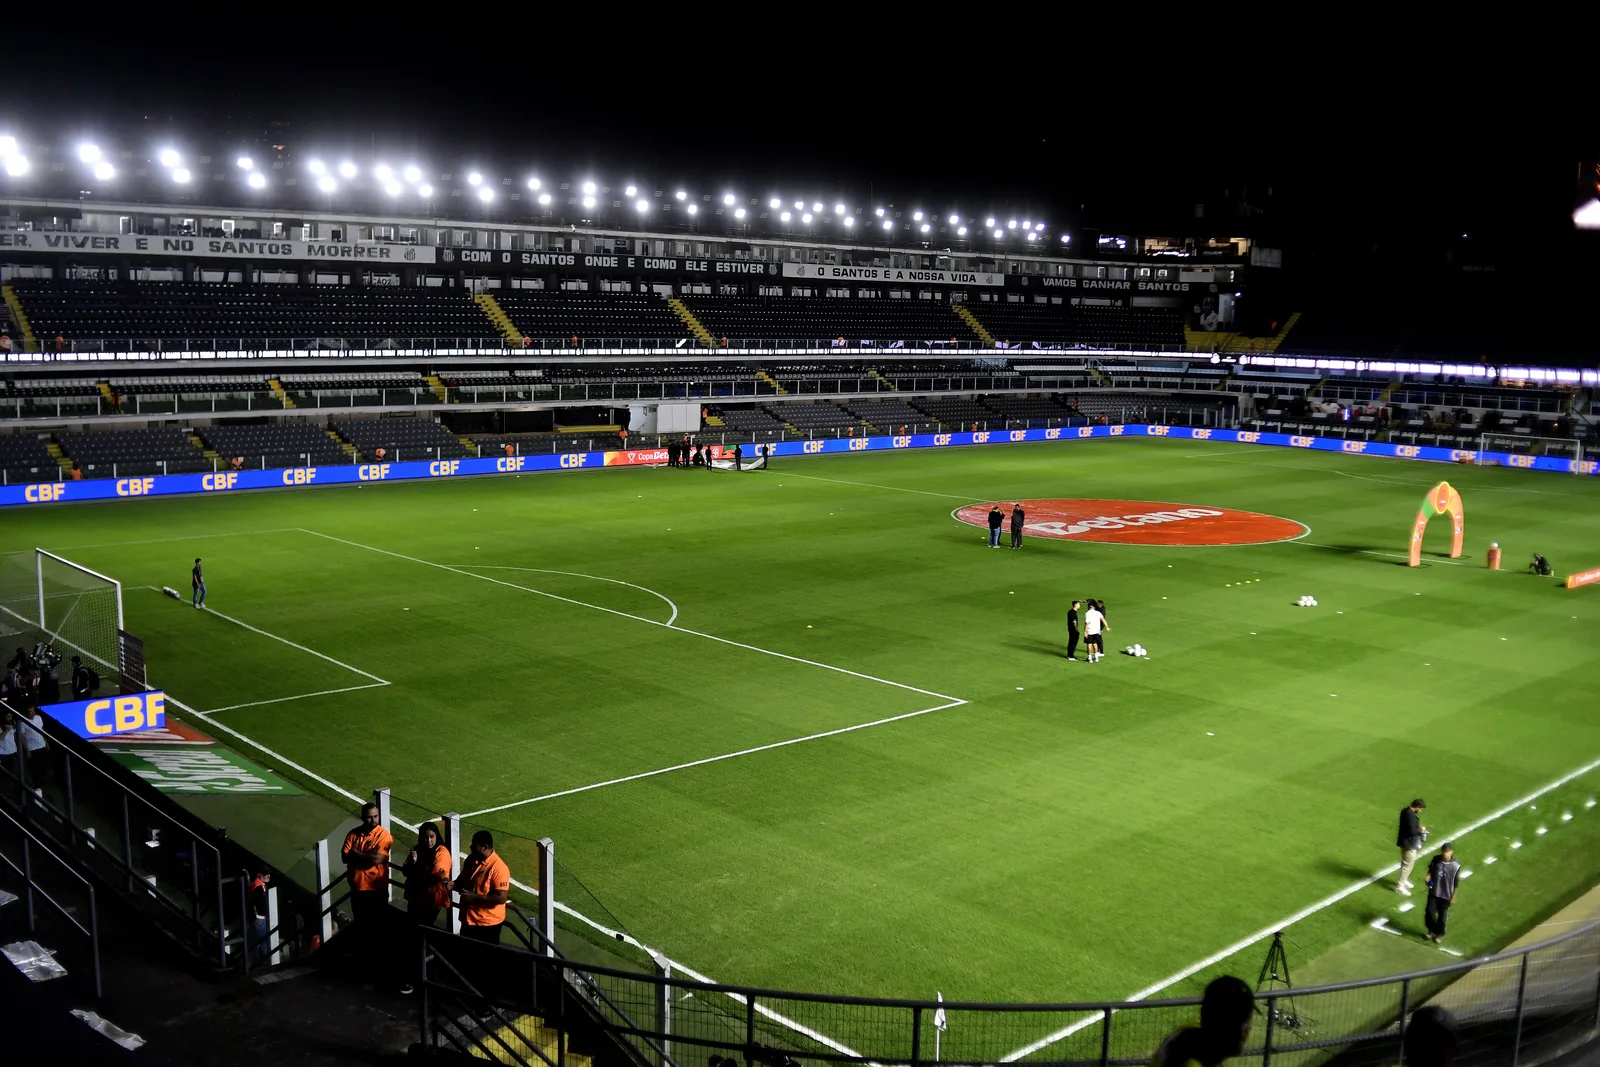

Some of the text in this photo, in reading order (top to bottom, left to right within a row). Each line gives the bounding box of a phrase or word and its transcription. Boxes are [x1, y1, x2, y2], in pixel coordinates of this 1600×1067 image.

[43, 235, 120, 250] VIVER
[135, 238, 149, 250] E
[163, 239, 194, 252] NO
[208, 240, 293, 256] SANTOS
[307, 244, 391, 259] MORRER
[461, 250, 765, 274] COM O SANTOS ONDE E COMO ELE ESTIVER
[817, 267, 977, 283] O SANTOS É A NOSSA VIDA
[1042, 275, 1192, 293] VAMOS GANHAR SANTOS
[973, 431, 989, 443] CBF
[1011, 430, 1025, 441] CBF
[1046, 428, 1060, 439] CBF
[1079, 427, 1092, 437] CBF
[1111, 425, 1123, 435] CBF
[1147, 425, 1169, 435] CBF
[1193, 429, 1211, 440] CBF
[1237, 431, 1259, 443] CBF
[849, 437, 868, 451] CBF
[893, 435, 911, 448] CBF
[934, 433, 951, 445] CBF
[1291, 435, 1314, 447] CBF
[755, 443, 777, 457] CF
[803, 440, 823, 453] CBF
[1343, 440, 1366, 454] CBF
[1395, 444, 1421, 457] CBF
[560, 453, 587, 468] CBF
[638, 453, 654, 461] Copa
[1509, 454, 1536, 468] CBF
[430, 460, 459, 476] CBF
[497, 457, 525, 472] CBF
[1569, 460, 1598, 473] CBF
[283, 467, 316, 485] CBF
[359, 463, 389, 481] CBF
[116, 477, 153, 496] CBF
[202, 473, 237, 490] CBF
[25, 483, 65, 502] CBF
[1023, 508, 1224, 536] Betano
[84, 693, 165, 735] CBF
